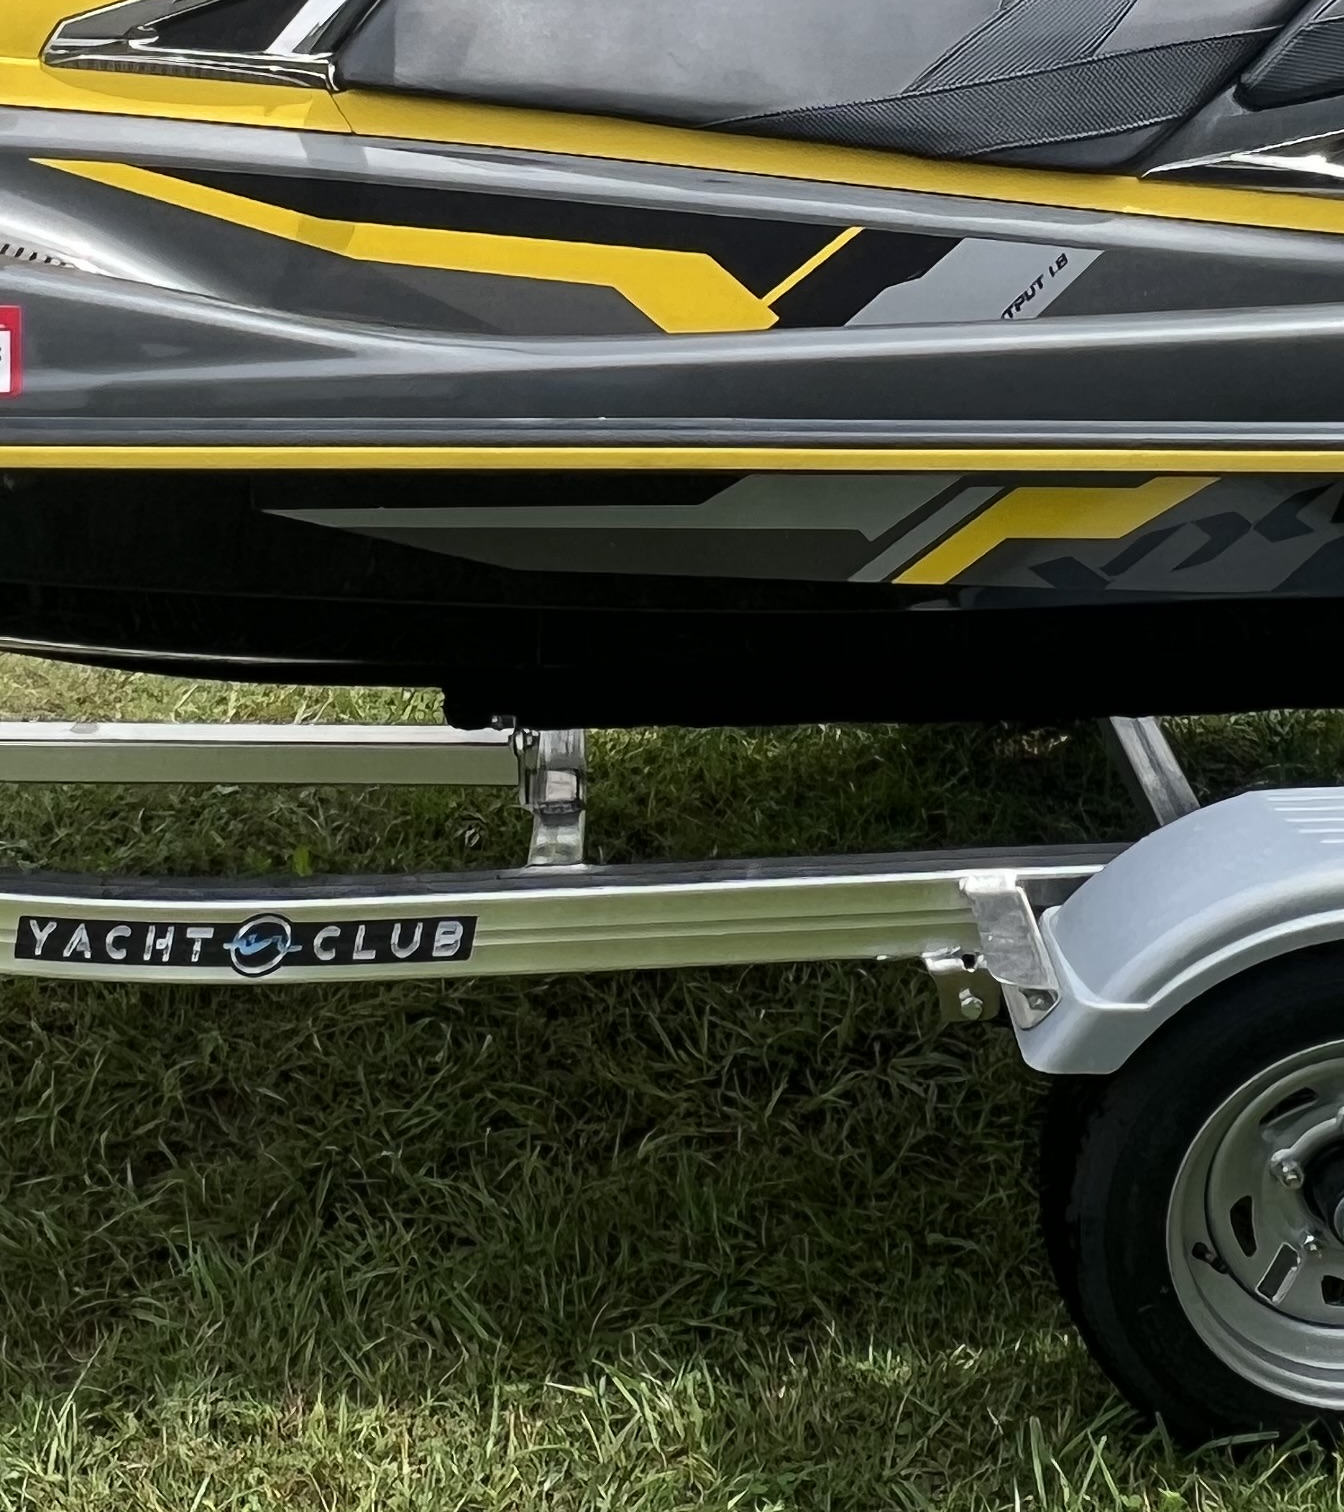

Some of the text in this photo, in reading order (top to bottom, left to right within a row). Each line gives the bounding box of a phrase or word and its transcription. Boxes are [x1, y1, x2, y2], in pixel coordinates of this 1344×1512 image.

[1000, 273, 1045, 320] TPUT
[29, 919, 464, 962] YACHT CLUB
